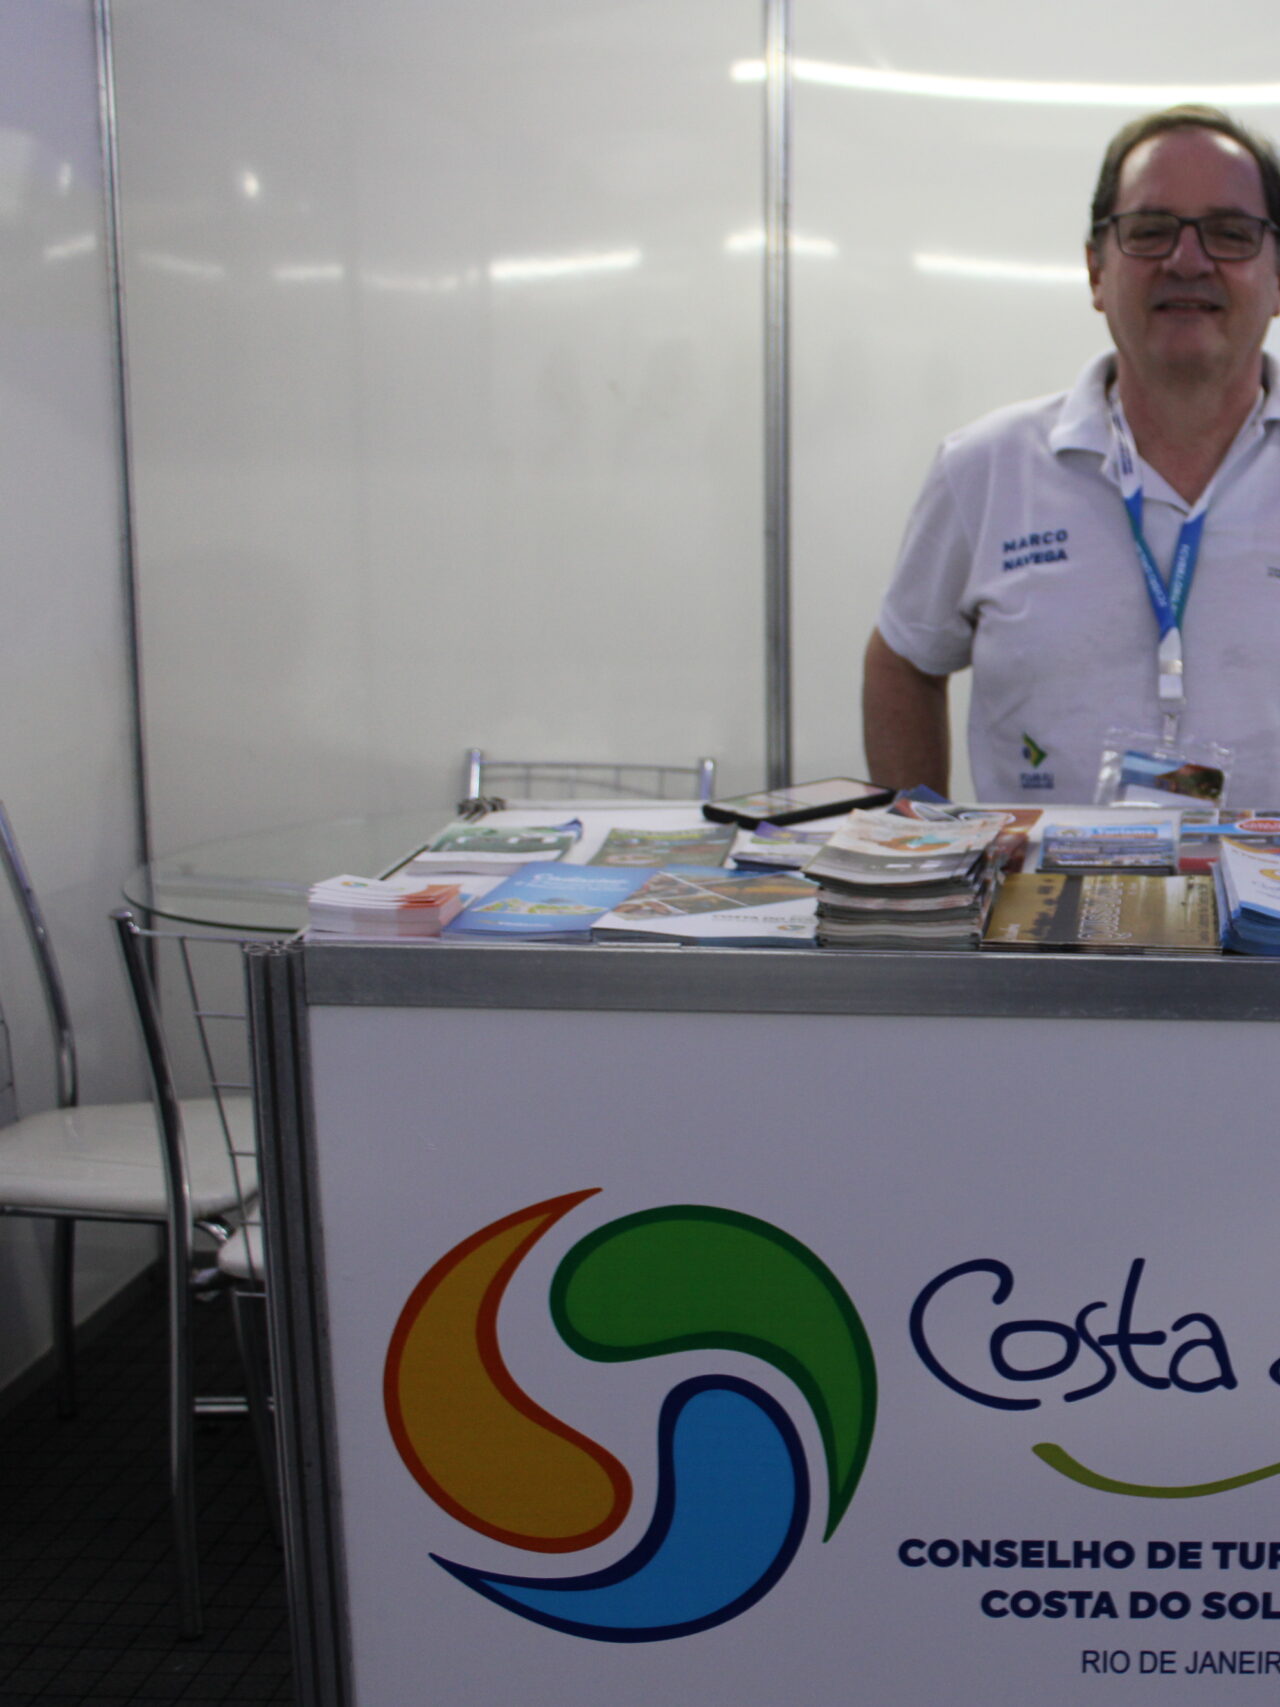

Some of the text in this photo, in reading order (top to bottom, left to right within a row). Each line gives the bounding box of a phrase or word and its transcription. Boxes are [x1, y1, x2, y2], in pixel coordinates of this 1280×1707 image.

[1003, 529, 1069, 553] MARCO
[1003, 548, 1069, 572] NAVEGA
[909, 1257, 1238, 1411] Costa
[898, 1538, 1136, 1569] CONSELHO
[1147, 1541, 1203, 1569] DE
[980, 1589, 1119, 1619] COSTA
[1129, 1591, 1192, 1620] DO
[1081, 1650, 1131, 1674] RIO
[1139, 1650, 1177, 1674] DE
